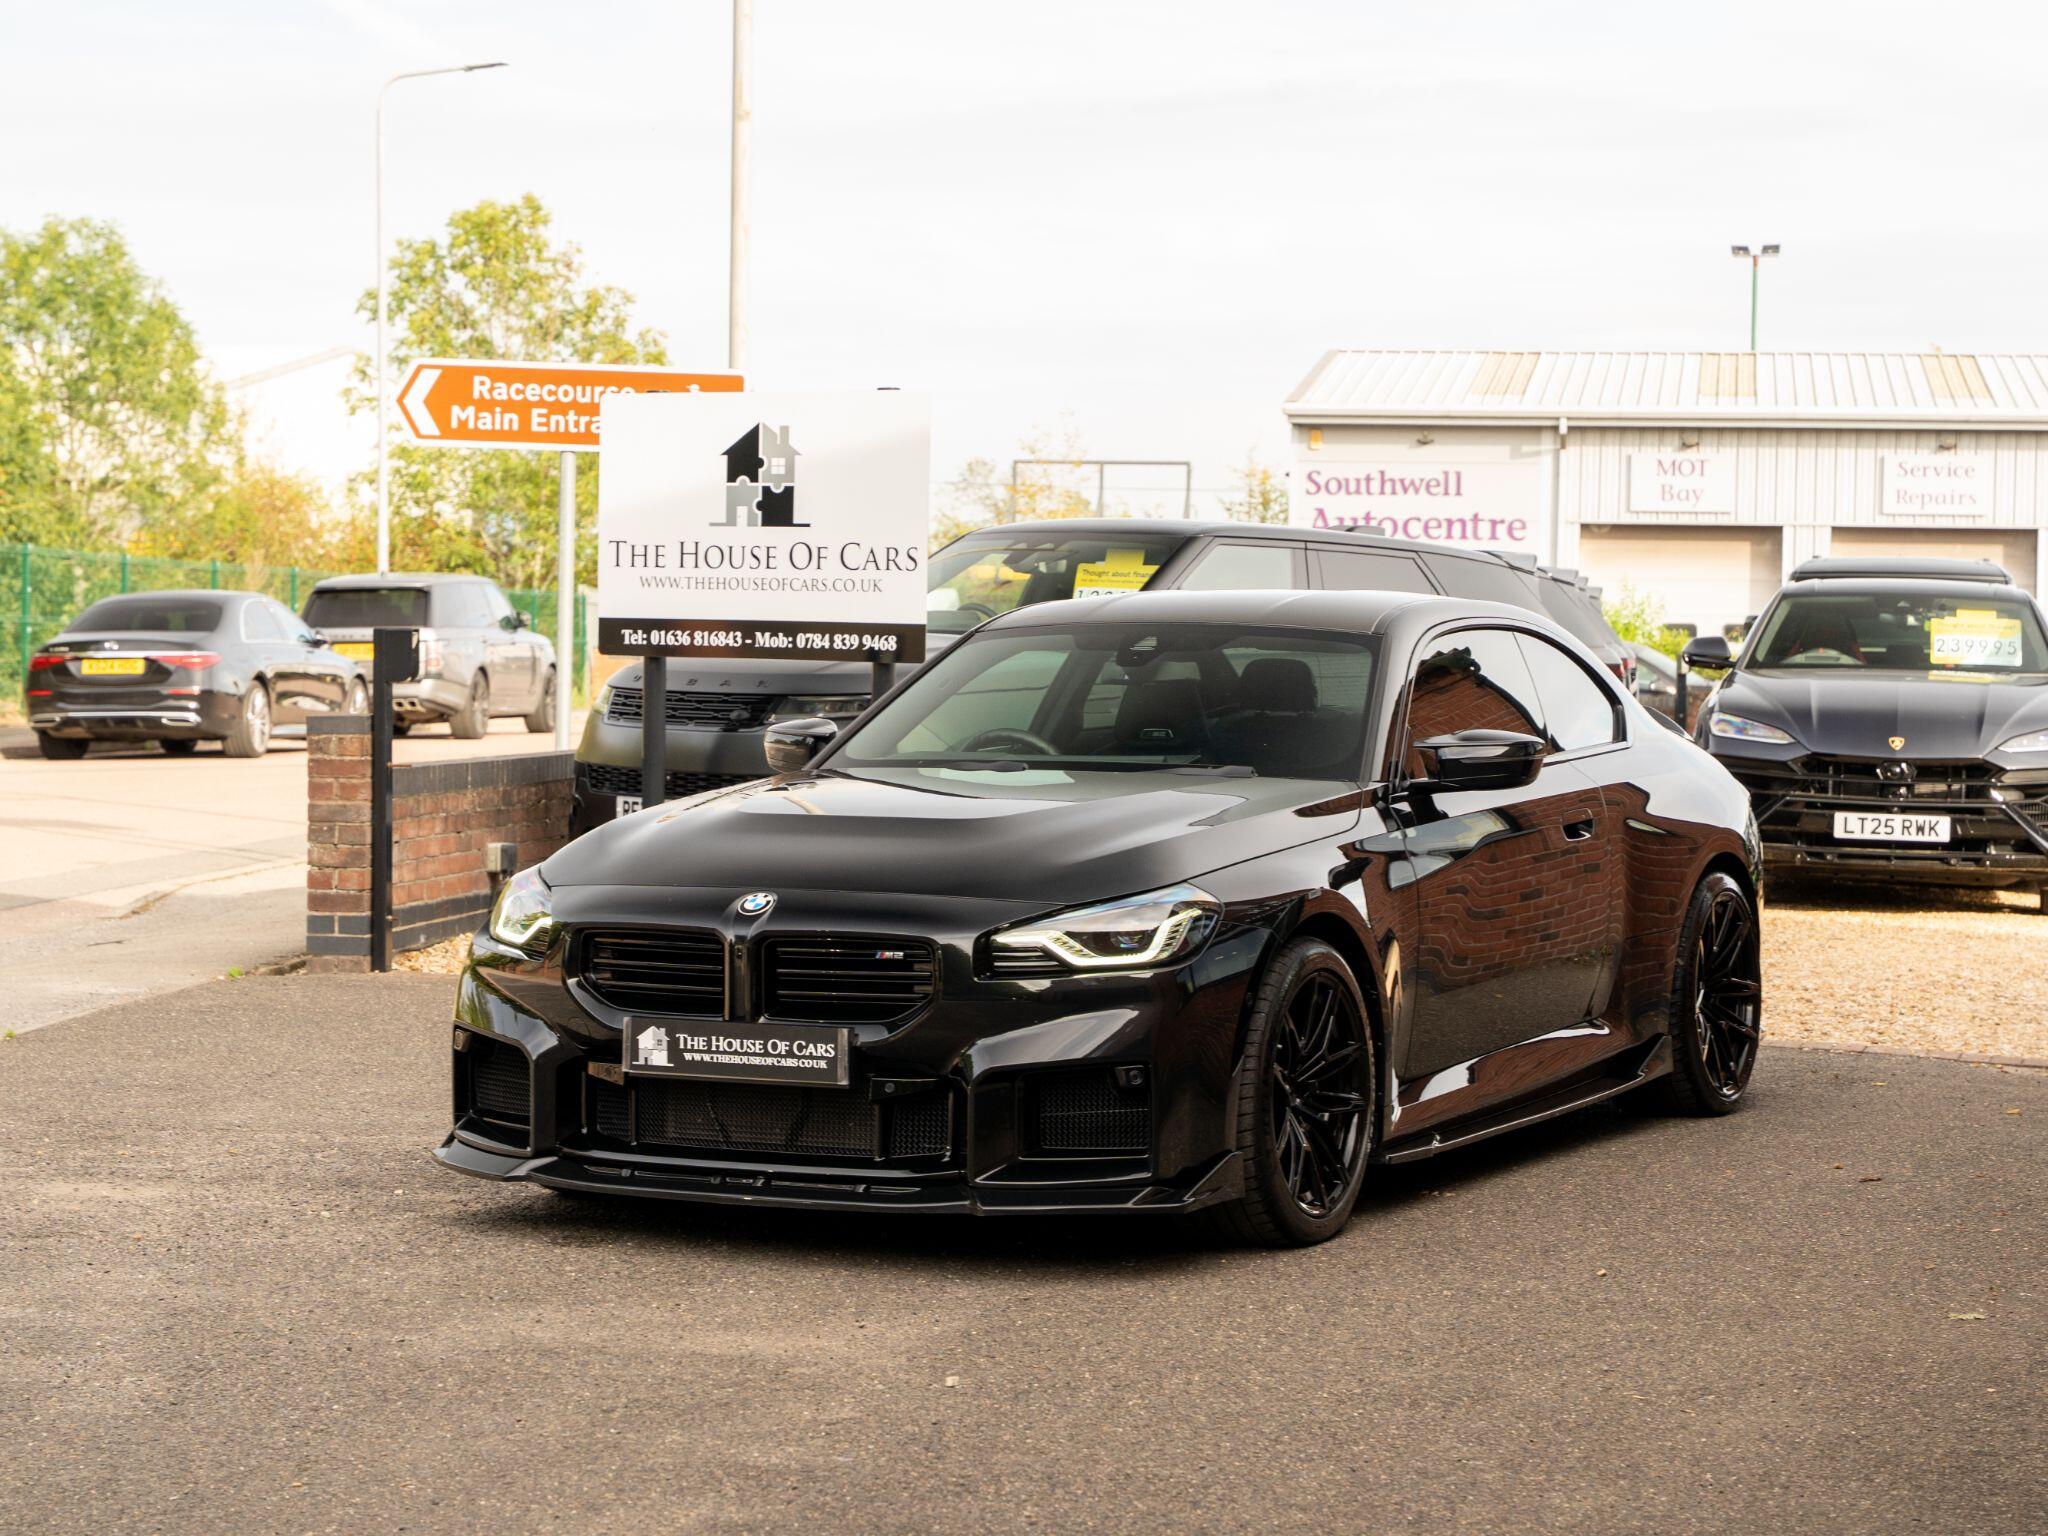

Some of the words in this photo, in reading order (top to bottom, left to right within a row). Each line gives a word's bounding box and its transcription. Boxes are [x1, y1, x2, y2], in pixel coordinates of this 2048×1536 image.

[450, 405, 519, 431] Main
[1656, 459, 1710, 477] MOT
[1897, 461, 1976, 479] Service
[1306, 470, 1463, 497] Southwell
[1660, 484, 1705, 507] Bay
[1896, 488, 1977, 510] Repairs
[609, 540, 667, 568] THE
[678, 541, 778, 570] HOUSE
[789, 542, 828, 571] OF
[840, 543, 918, 572] CARS
[640, 576, 883, 592] WWW.THEHOUSEOFCARS.CO.UK
[1082, 569, 1110, 579] Thought
[621, 629, 647, 645] Tel:
[650, 630, 691, 646] 01636
[693, 631, 743, 647] 816843
[754, 632, 793, 648] Mob:
[796, 633, 831, 649] 0784
[833, 633, 858, 650] 839
[861, 635, 897, 651] 9468
[1936, 638, 2017, 655] 239995
[1844, 817, 1895, 835] LT25
[1902, 819, 1940, 837] RWK
[676, 1033, 707, 1050] THE
[711, 1035, 765, 1054] HOUSE
[767, 1039, 790, 1055] OF
[793, 1040, 836, 1058] CARS
